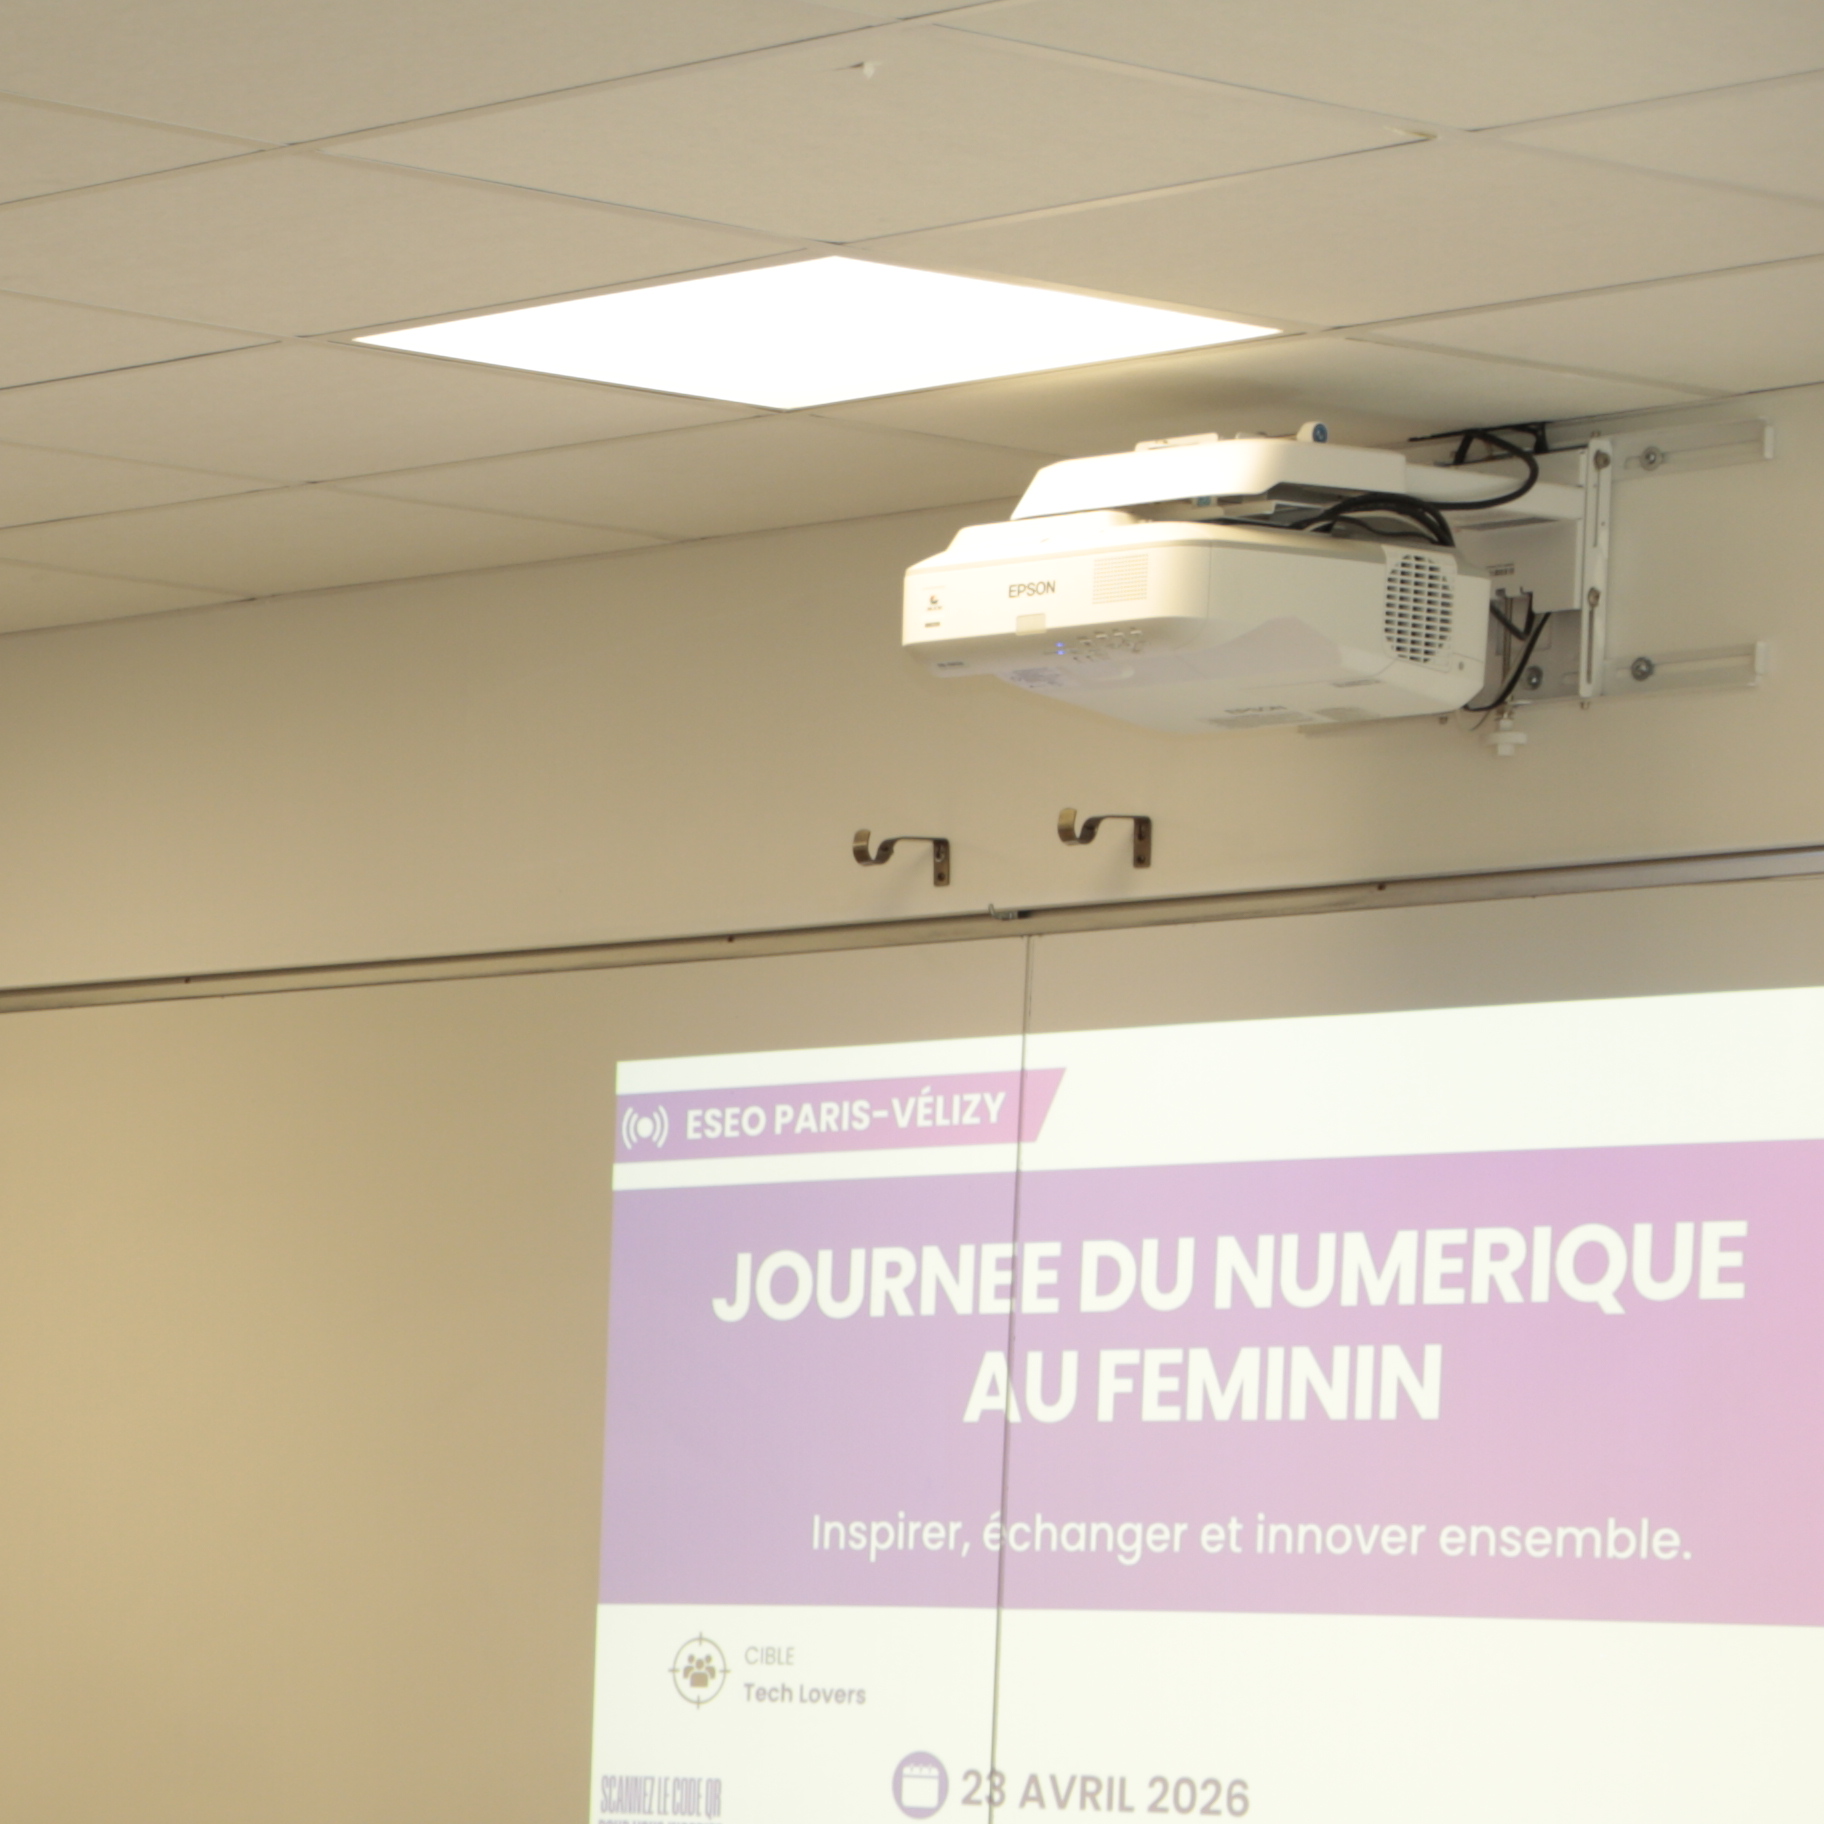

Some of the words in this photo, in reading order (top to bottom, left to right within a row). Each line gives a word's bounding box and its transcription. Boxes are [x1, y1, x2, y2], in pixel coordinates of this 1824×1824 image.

[1008, 580, 1056, 599] EPSON
[685, 1106, 765, 1141] ESEO
[773, 1085, 1006, 1135] PARIS-VÉLIZY
[712, 1240, 1063, 1324] JOURNEE
[1079, 1233, 1196, 1313] DU
[1214, 1219, 1748, 1315] NUMERIQUE
[963, 1351, 1080, 1424] AU
[1097, 1343, 1444, 1421] FEMININ
[812, 1512, 970, 1563] Inspirer,
[982, 1512, 1188, 1566] échanger
[1200, 1516, 1244, 1554] et
[1256, 1512, 1426, 1556] innover
[1438, 1517, 1692, 1561] ensemble.
[744, 1646, 795, 1666] CIBLE
[743, 1683, 793, 1703] Tech
[799, 1683, 867, 1705] Lovers
[600, 1775, 655, 1815] SCANNEZ
[657, 1777, 669, 1816] LE
[672, 1777, 703, 1817] CODE
[705, 1778, 722, 1820] QR
[961, 1769, 1007, 1808] 23
[1019, 1774, 1135, 1812] AVRIL
[1147, 1776, 1250, 1818] 2026
